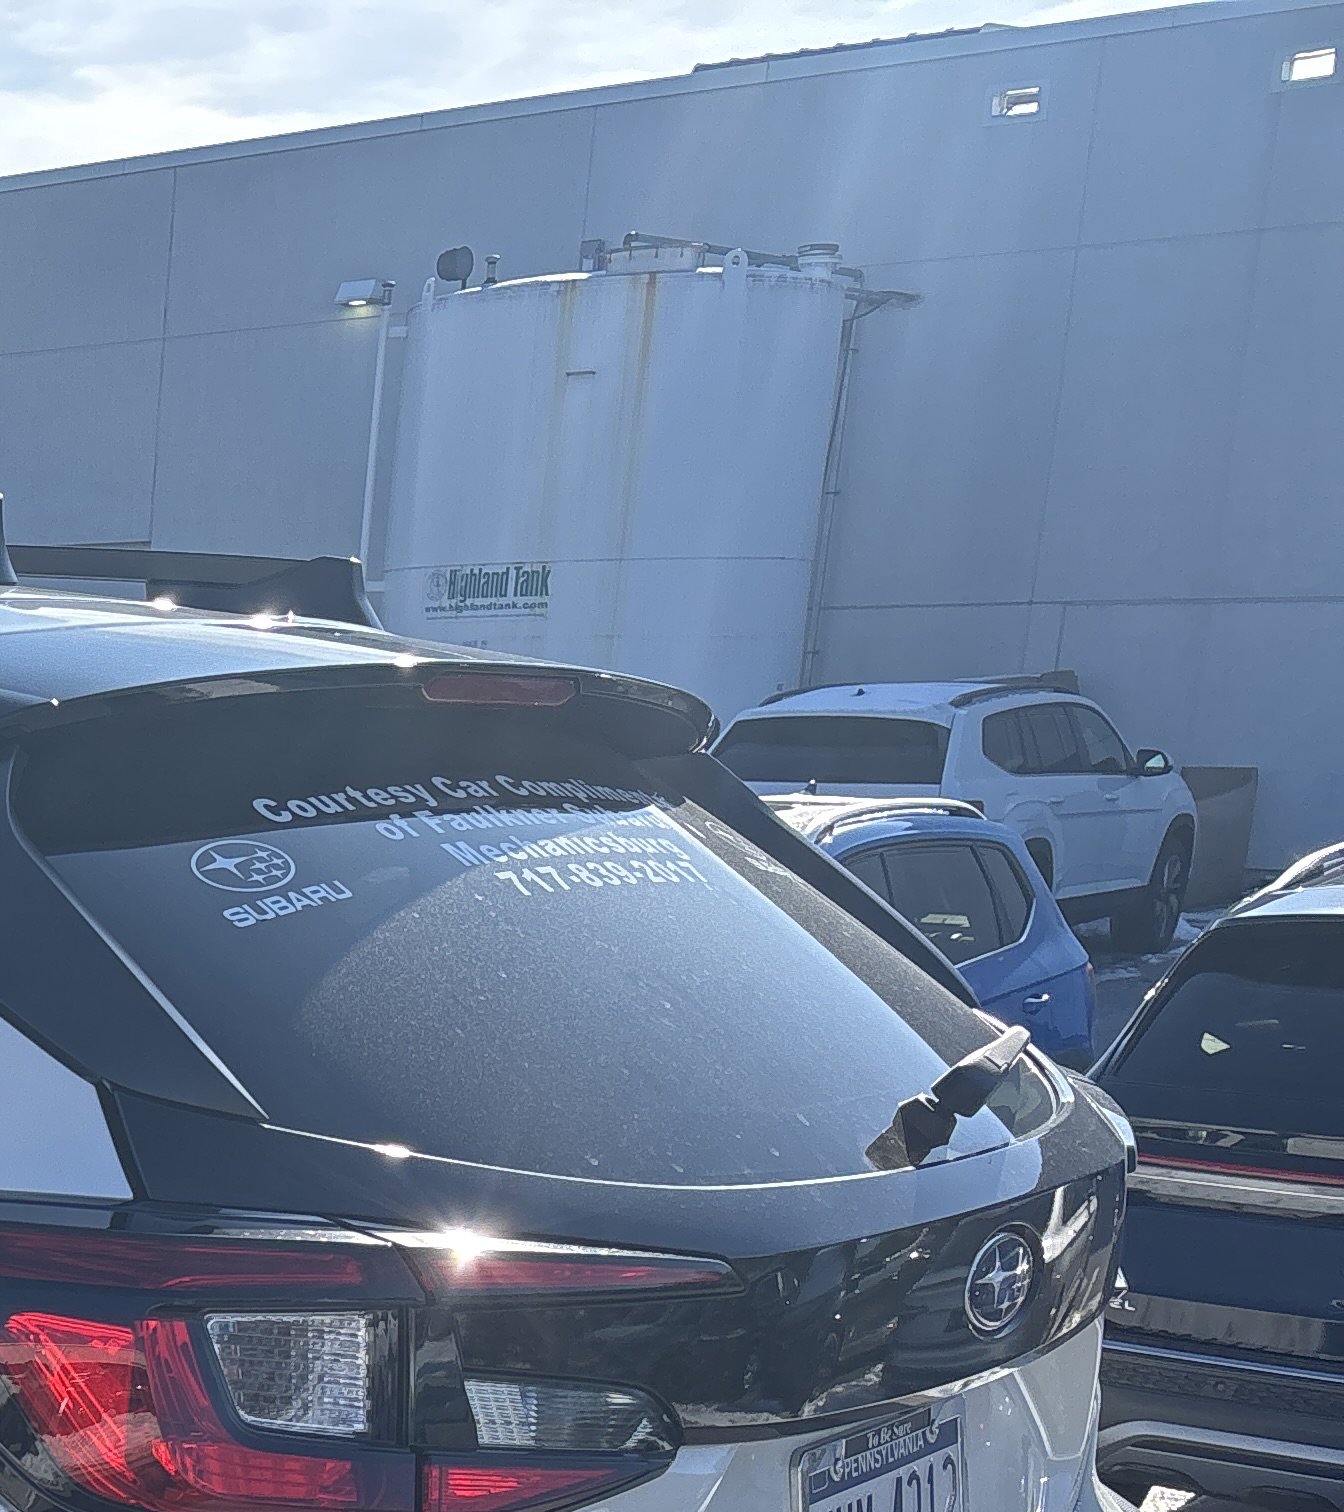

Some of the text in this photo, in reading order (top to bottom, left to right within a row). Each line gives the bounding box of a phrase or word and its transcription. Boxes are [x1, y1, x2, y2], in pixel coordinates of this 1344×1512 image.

[447, 565, 552, 604] Highland Tank
[252, 781, 440, 823] Courtesy
[430, 775, 500, 799] Car
[374, 813, 421, 841] of
[413, 804, 566, 835] Faulkner
[439, 830, 691, 868] Mechanicsburg
[222, 879, 354, 929] SUBARU
[843, 1431, 925, 1481] PENNSYLVANIA
[866, 1430, 879, 1449] To
[880, 1425, 892, 1444] Be
